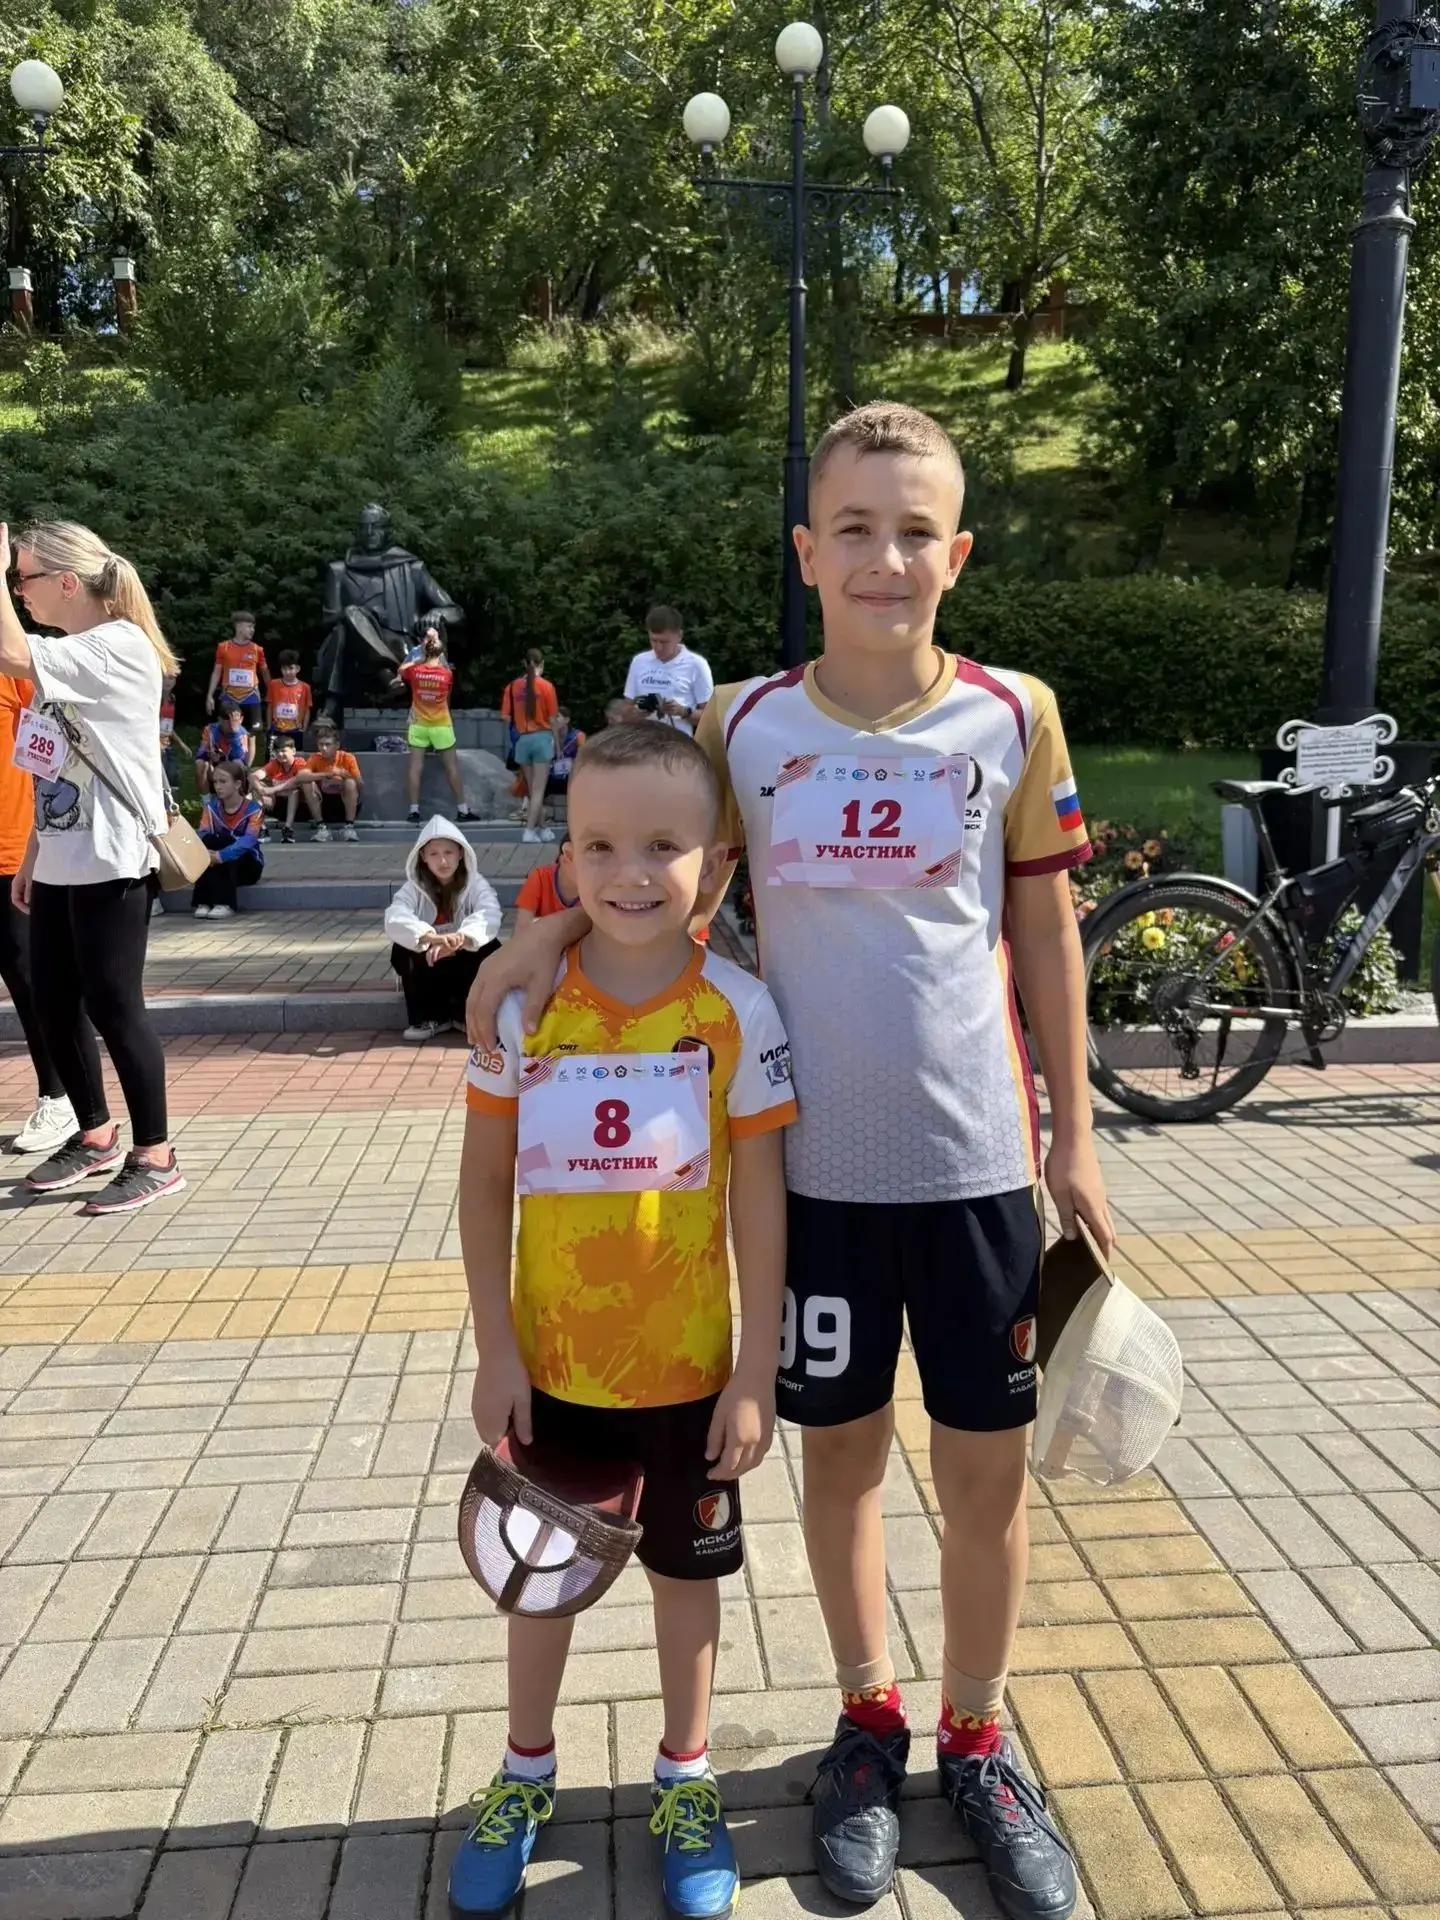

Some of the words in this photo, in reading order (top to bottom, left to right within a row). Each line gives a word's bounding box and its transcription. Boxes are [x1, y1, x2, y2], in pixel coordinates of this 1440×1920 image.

[29, 733, 55, 756] 289
[841, 799, 903, 838] 12
[816, 844, 916, 859] УЧАСТНИК
[593, 1099, 631, 1148] 8
[568, 1156, 658, 1172] УЧАСТНИК
[693, 1525, 739, 1548] ИСКРА
